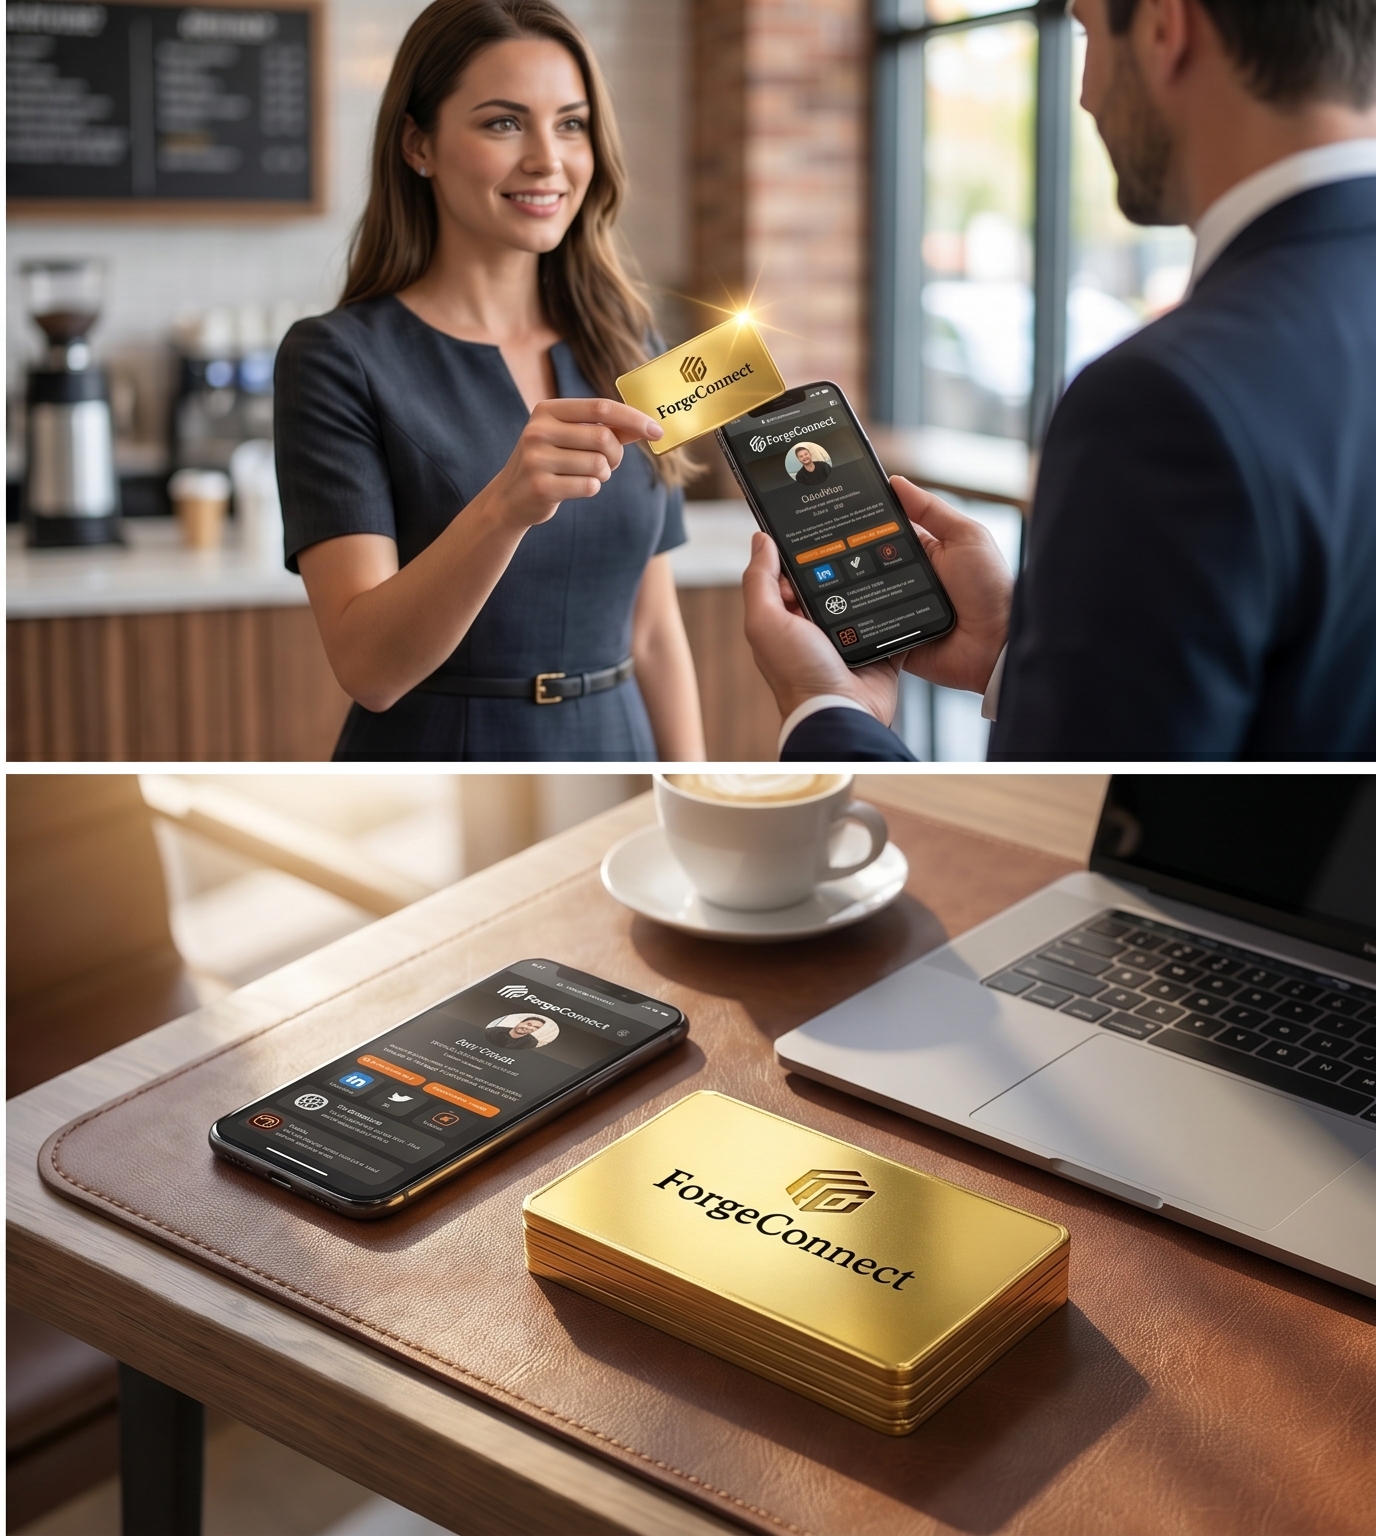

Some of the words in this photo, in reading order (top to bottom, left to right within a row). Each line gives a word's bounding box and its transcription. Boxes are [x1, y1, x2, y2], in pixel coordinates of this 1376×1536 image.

[656, 363, 755, 420] ForgeConnect
[766, 416, 837, 445] ForgeConnect
[524, 994, 610, 1030] ForgeConnect
[653, 1168, 917, 1292] ForgeConnect
